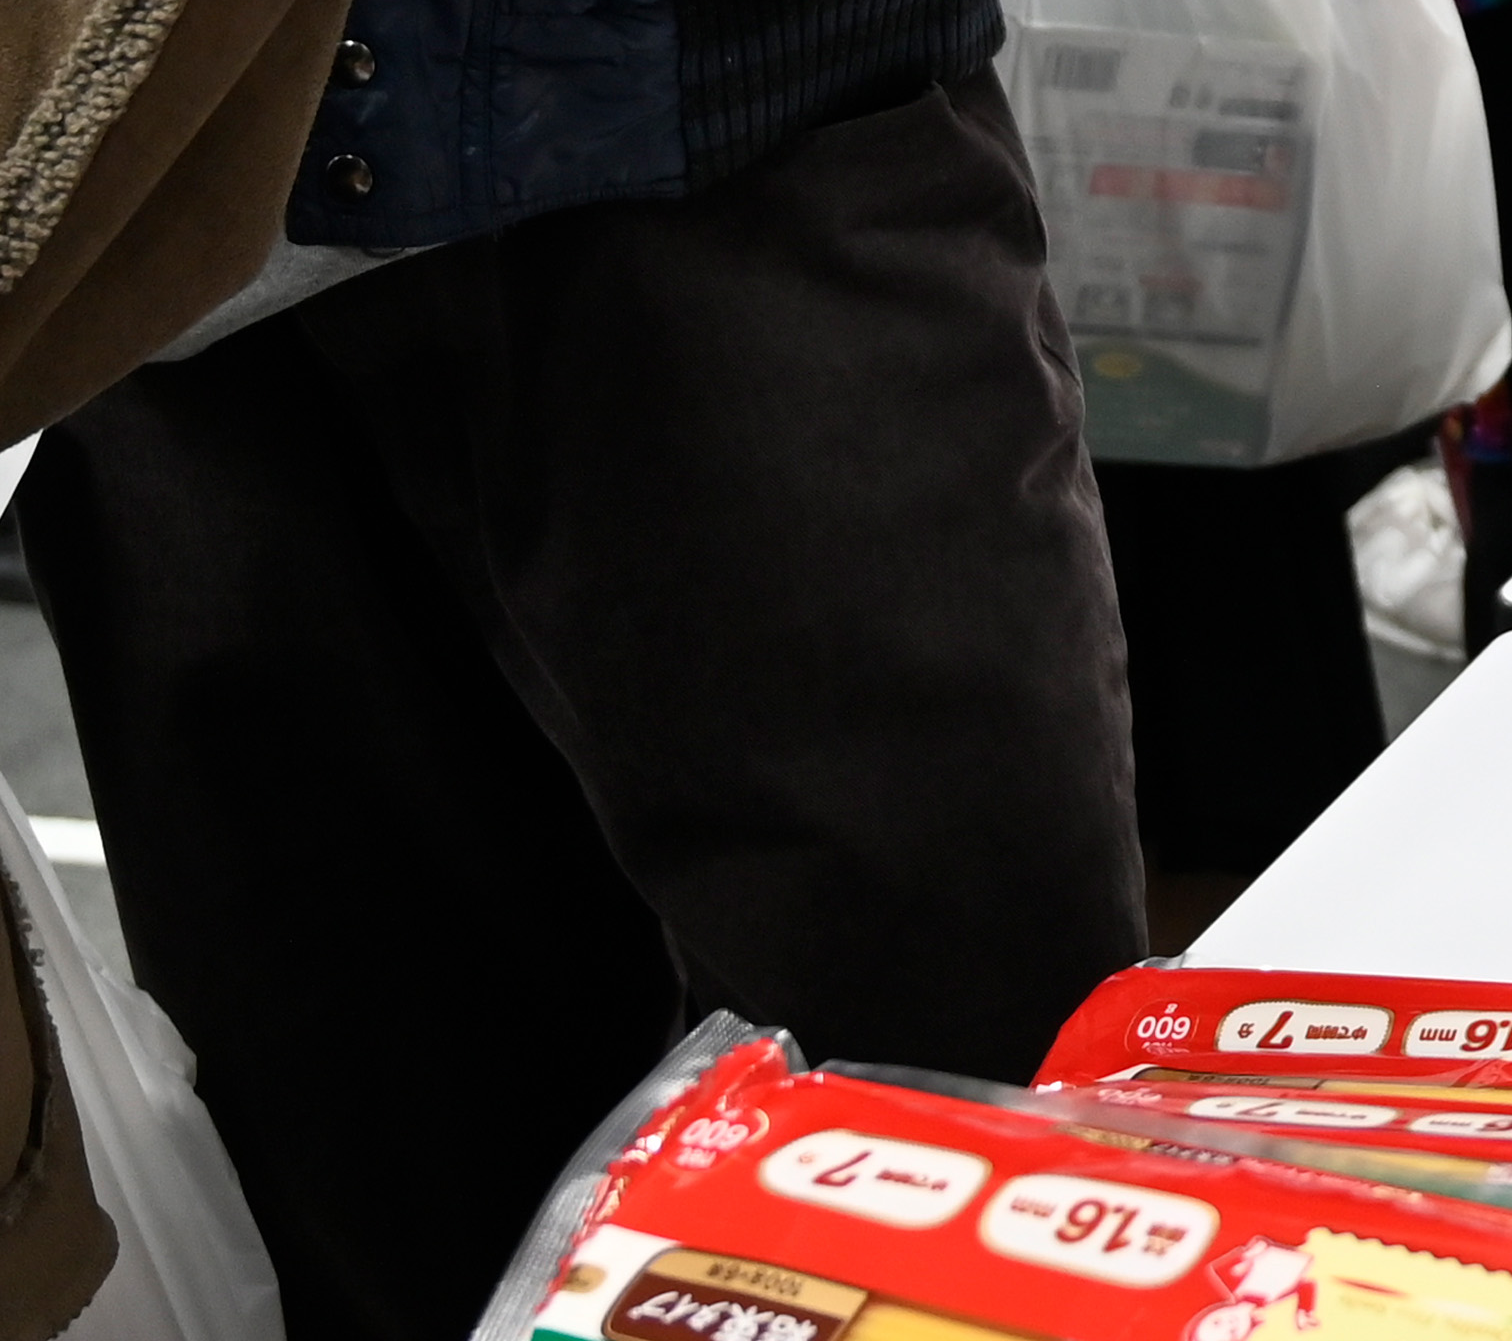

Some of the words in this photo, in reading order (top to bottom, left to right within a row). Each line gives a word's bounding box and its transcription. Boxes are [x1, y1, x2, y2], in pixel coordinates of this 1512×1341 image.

[1136, 1015, 1191, 1041] 600
[1238, 1022, 1255, 1039] 分
[1257, 1010, 1294, 1051] 7
[1305, 1024, 1367, 1041] ゆで時間
[1419, 1027, 1457, 1041] mm
[680, 1118, 750, 1151] 600
[811, 1150, 872, 1191] 7
[1052, 1198, 1137, 1255] 1.6
